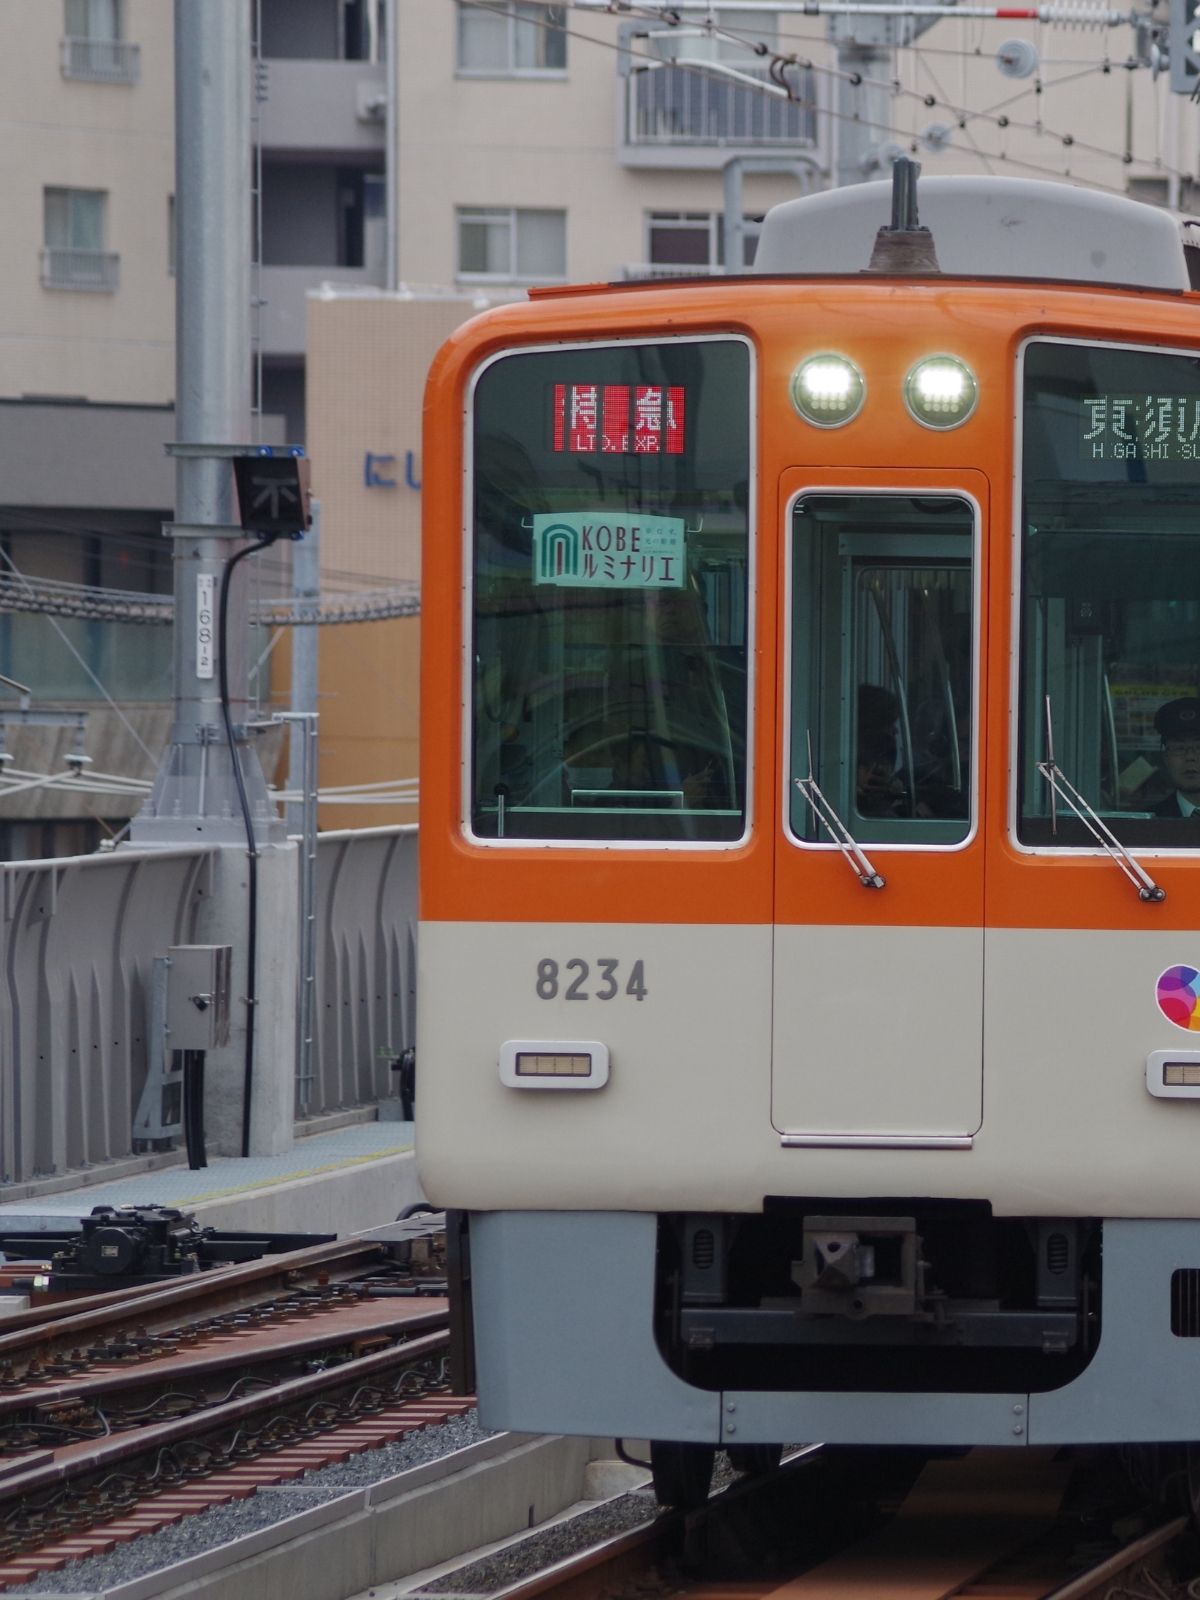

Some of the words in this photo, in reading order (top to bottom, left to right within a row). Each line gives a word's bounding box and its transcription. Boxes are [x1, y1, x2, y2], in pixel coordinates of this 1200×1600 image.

[562, 386, 677, 430] 特急
[582, 526, 640, 552] KOBE
[581, 553, 675, 583] ルミナリエ
[536, 958, 648, 1001] 8234
